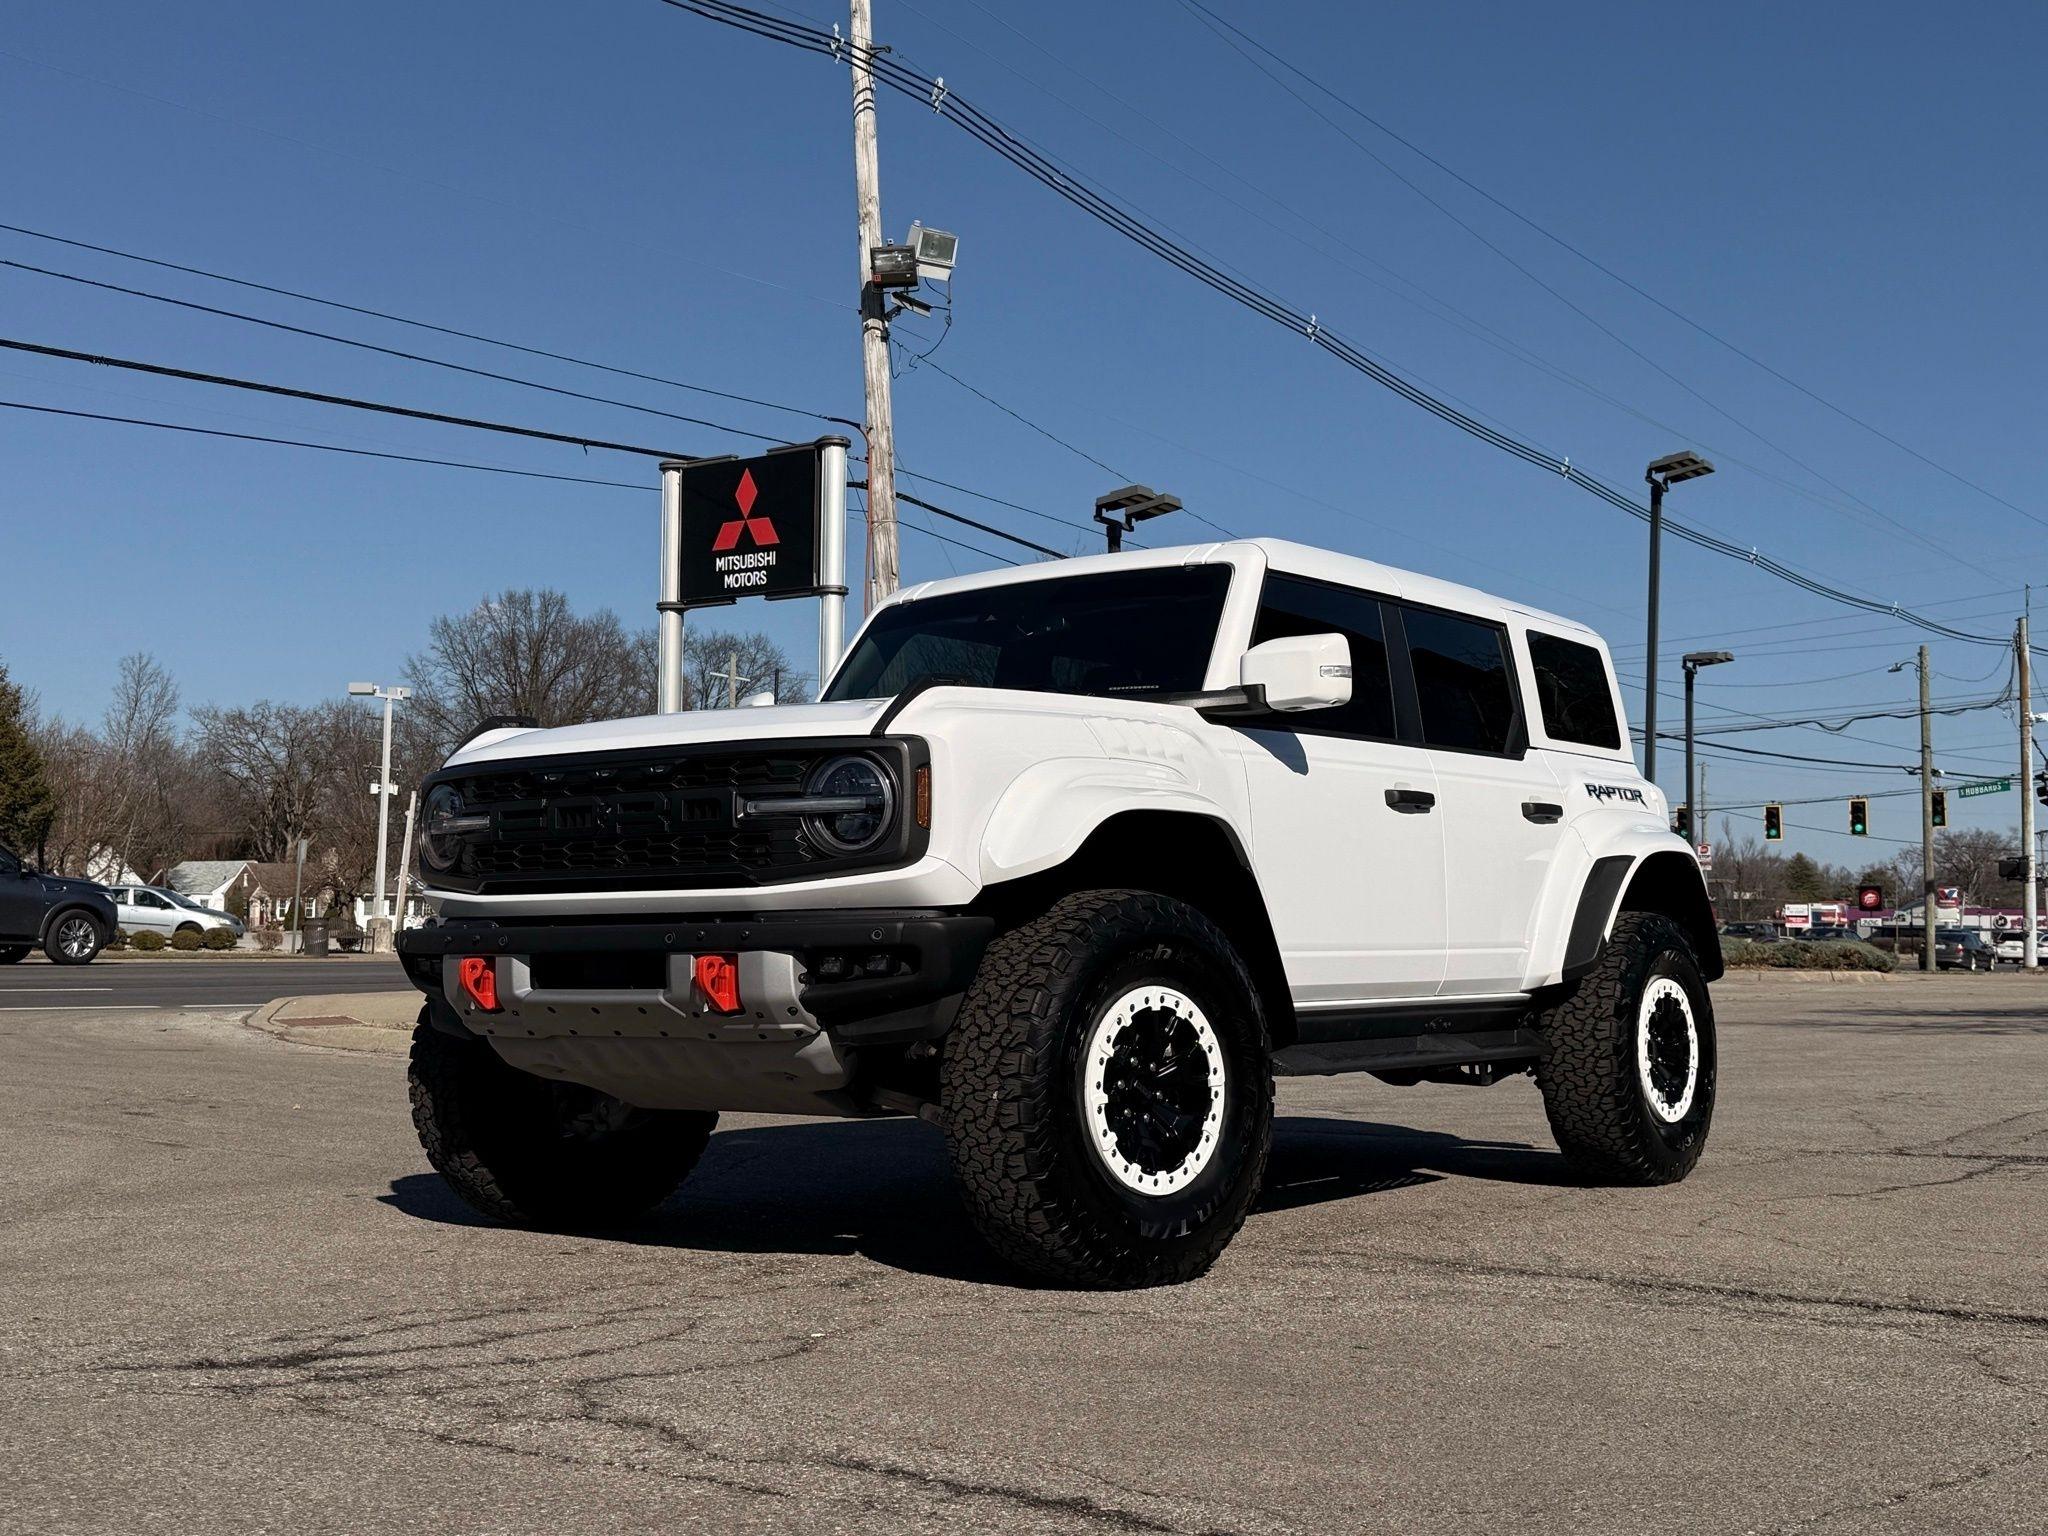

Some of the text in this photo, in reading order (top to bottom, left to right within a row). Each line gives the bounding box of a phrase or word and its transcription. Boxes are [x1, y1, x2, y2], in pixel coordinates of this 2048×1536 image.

[715, 550, 776, 572] MITSUBISHI
[724, 570, 767, 589] MOTORS
[1584, 782, 1649, 810] RAPTOR
